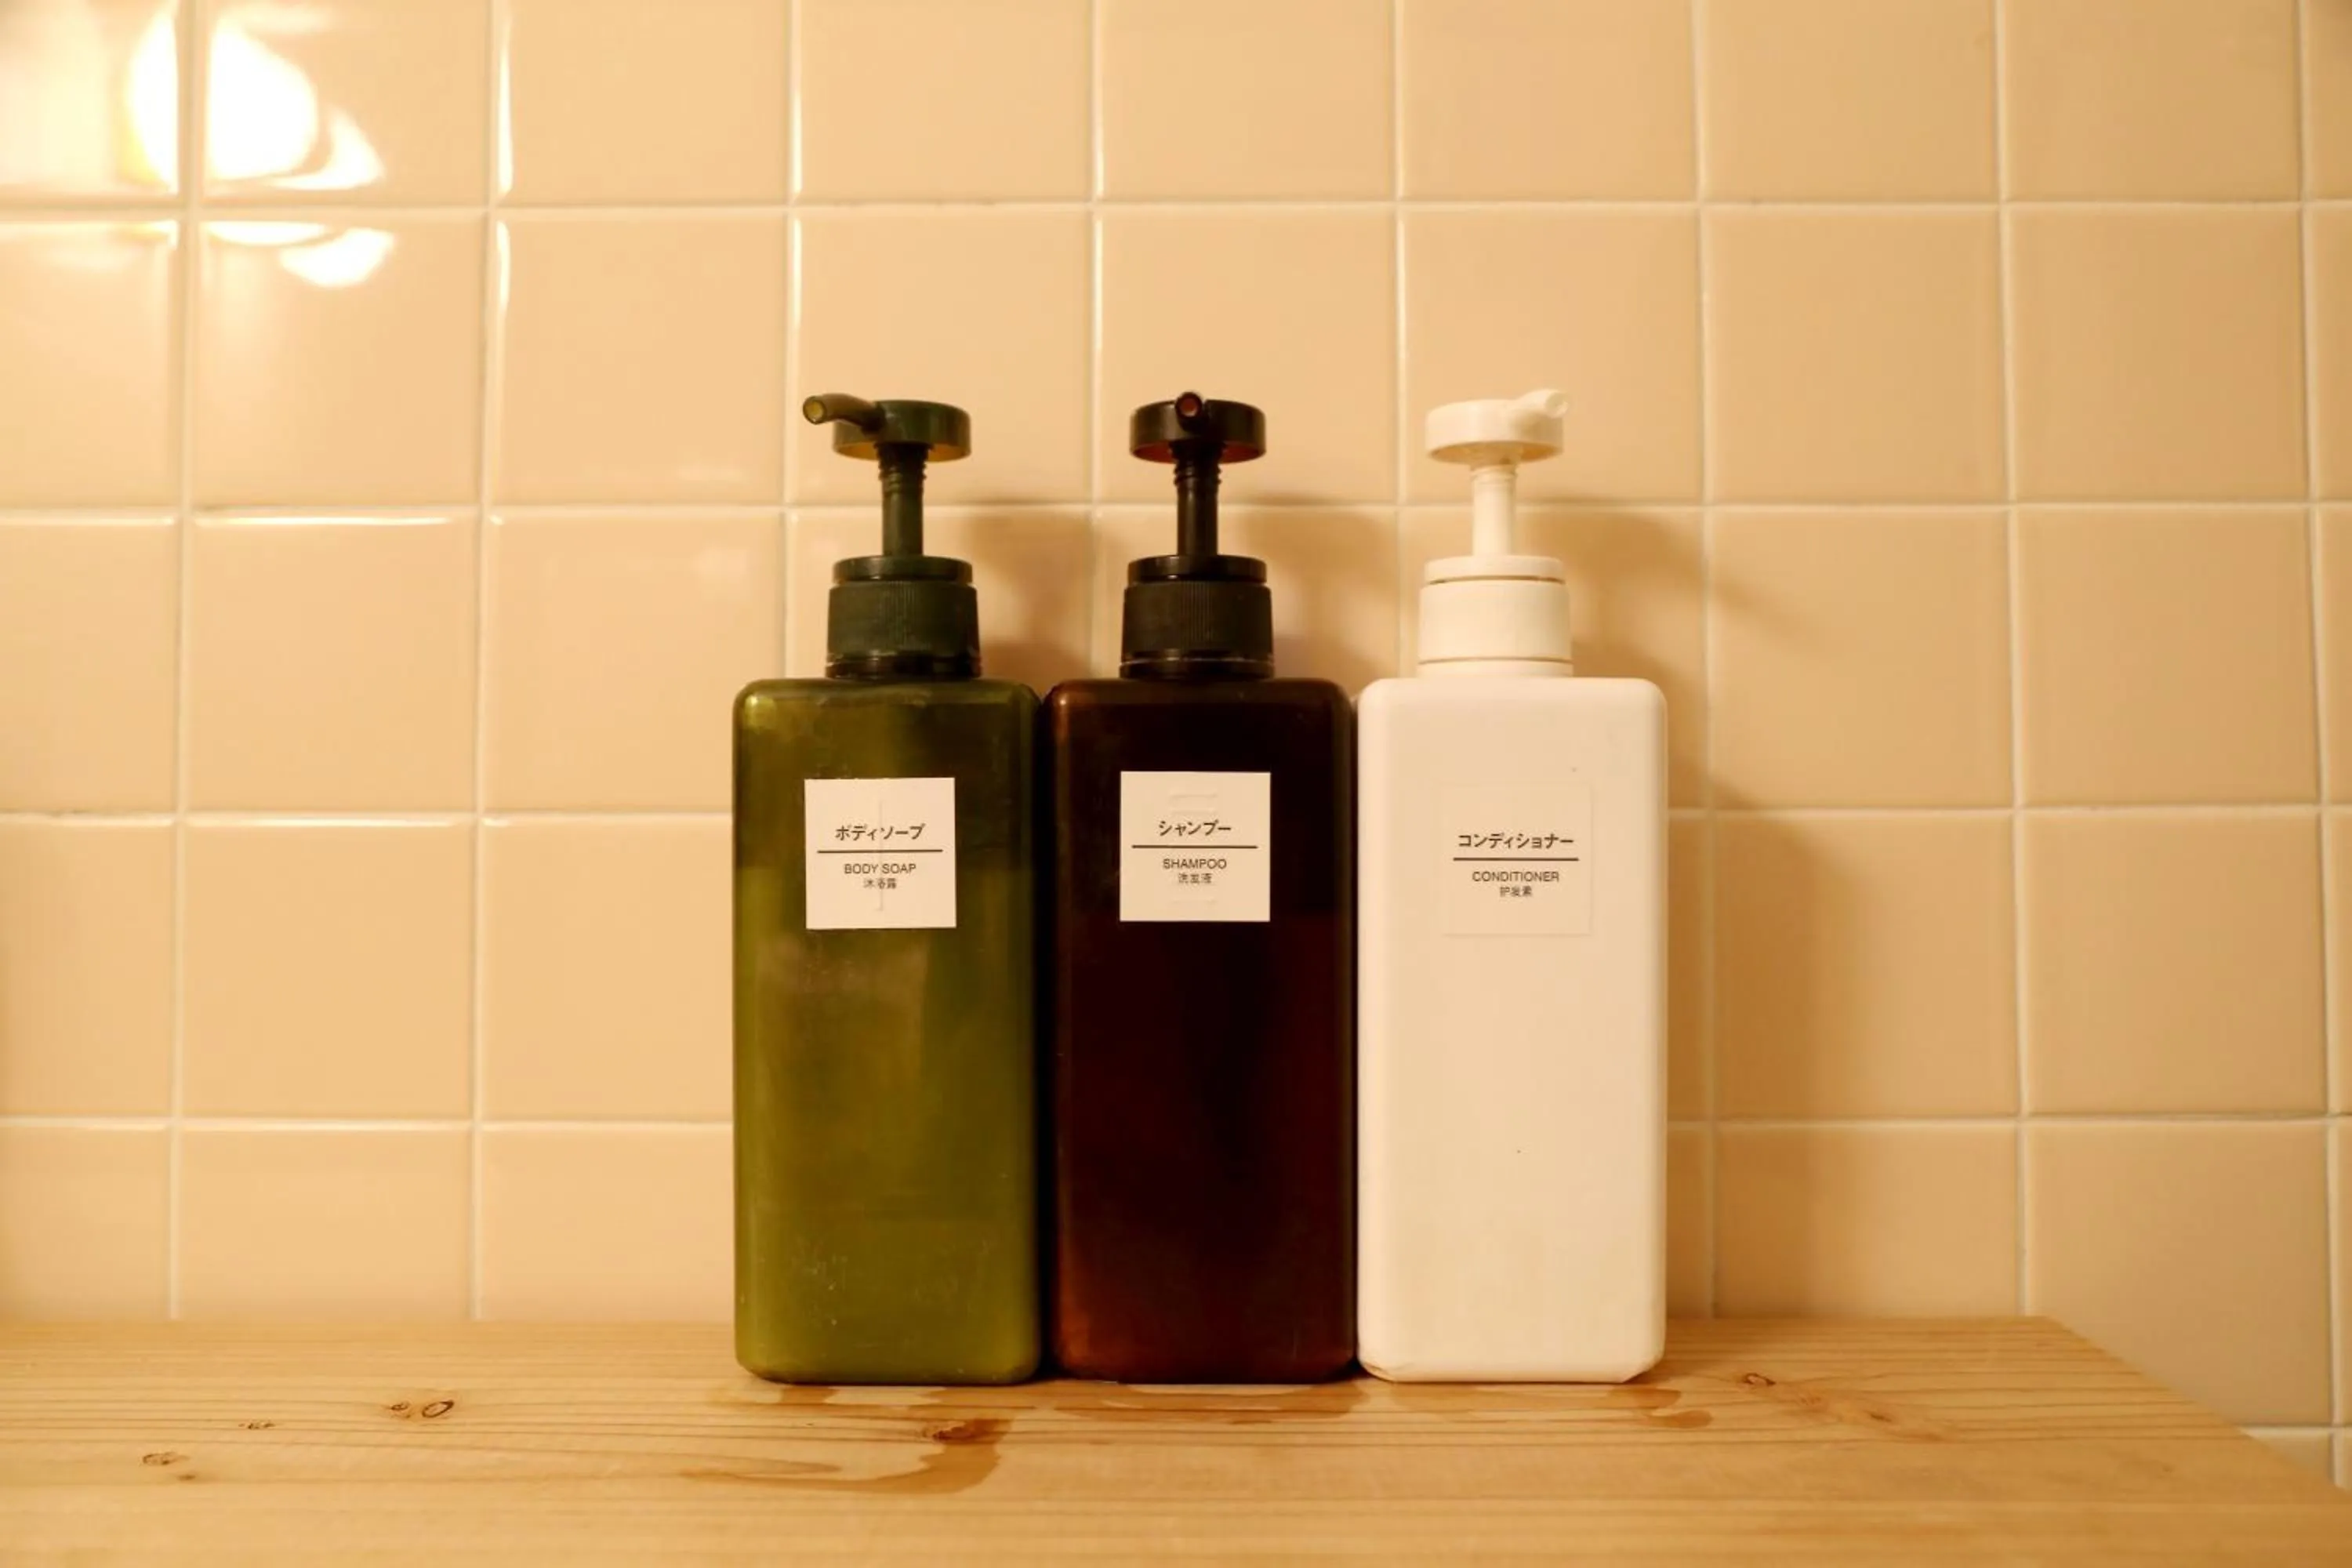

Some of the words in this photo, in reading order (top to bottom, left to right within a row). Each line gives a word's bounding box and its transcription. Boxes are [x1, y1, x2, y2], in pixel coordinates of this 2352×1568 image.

[835, 822, 926, 841] ボディソープ
[1158, 818, 1232, 837] シャンプー
[1457, 832, 1574, 850] コンディショナー
[844, 863, 879, 875] BODY
[880, 863, 916, 875] SOAP
[1162, 858, 1228, 870] SHAMPOO
[1472, 870, 1560, 883] CONDITIONER
